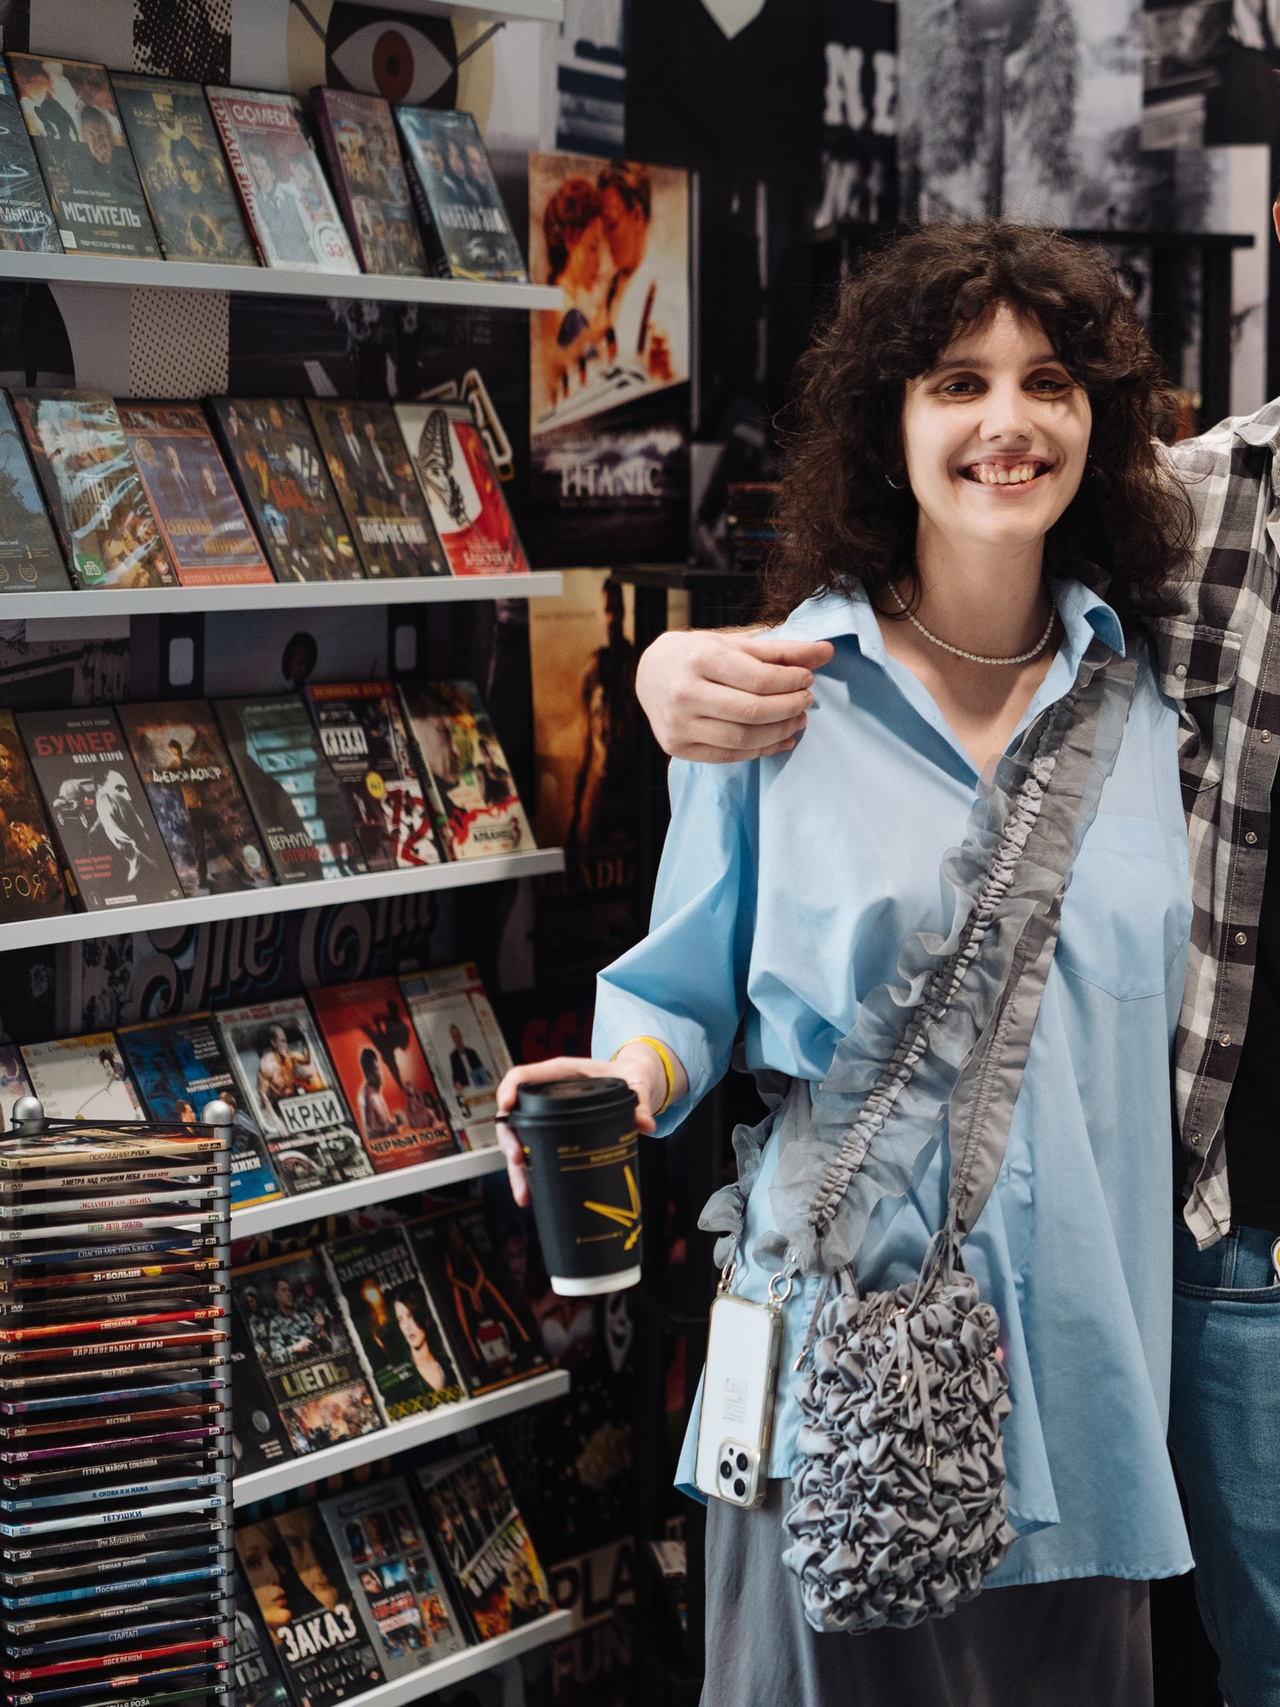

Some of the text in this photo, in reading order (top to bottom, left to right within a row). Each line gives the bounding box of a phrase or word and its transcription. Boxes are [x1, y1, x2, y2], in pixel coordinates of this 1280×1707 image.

[232, 105, 293, 128] COMEDY
[61, 201, 142, 228] МСТИТЕЛЬ
[325, 242, 344, 259] 33
[34, 731, 117, 756] БУМЕР
[268, 832, 313, 851] ВЕРНУТЬ
[369, 1134, 419, 1153] ЧЕРНЫЙ
[90, 1149, 150, 1161] ПОСЛЕДНИЙ РУБЕЖ
[66, 1178, 85, 1186] МЕТРА
[100, 1175, 124, 1183] УРОВНЕМ
[79, 1200, 114, 1209] ЭКЗАМЕН
[129, 1196, 152, 1205] ДВОИХ
[122, 1221, 143, 1230] ЛЮБОВЬ
[78, 1244, 154, 1259] СПАСТИ МИСТЕРА БЭНКСА
[106, 1269, 141, 1280] БОЛЬШЕ
[73, 1340, 164, 1356] ПАРАЛЛЕЛЬНЫЕ МИРЫ
[83, 1459, 158, 1476] ГЕТЕРЫ МАЙОРА СОКОЛОВА
[99, 1489, 119, 1498] СНОВА
[131, 1485, 148, 1494] МАМА
[102, 1510, 142, 1522] ТЕТУШКИ
[98, 1558, 146, 1571] ТЁМНАЯ ДОЛИНА
[109, 1629, 139, 1642] СТАРТАП
[278, 1603, 357, 1662] ЗАКАЗ
[103, 1654, 143, 1666] ПОСЕЛЕНЦЫ
